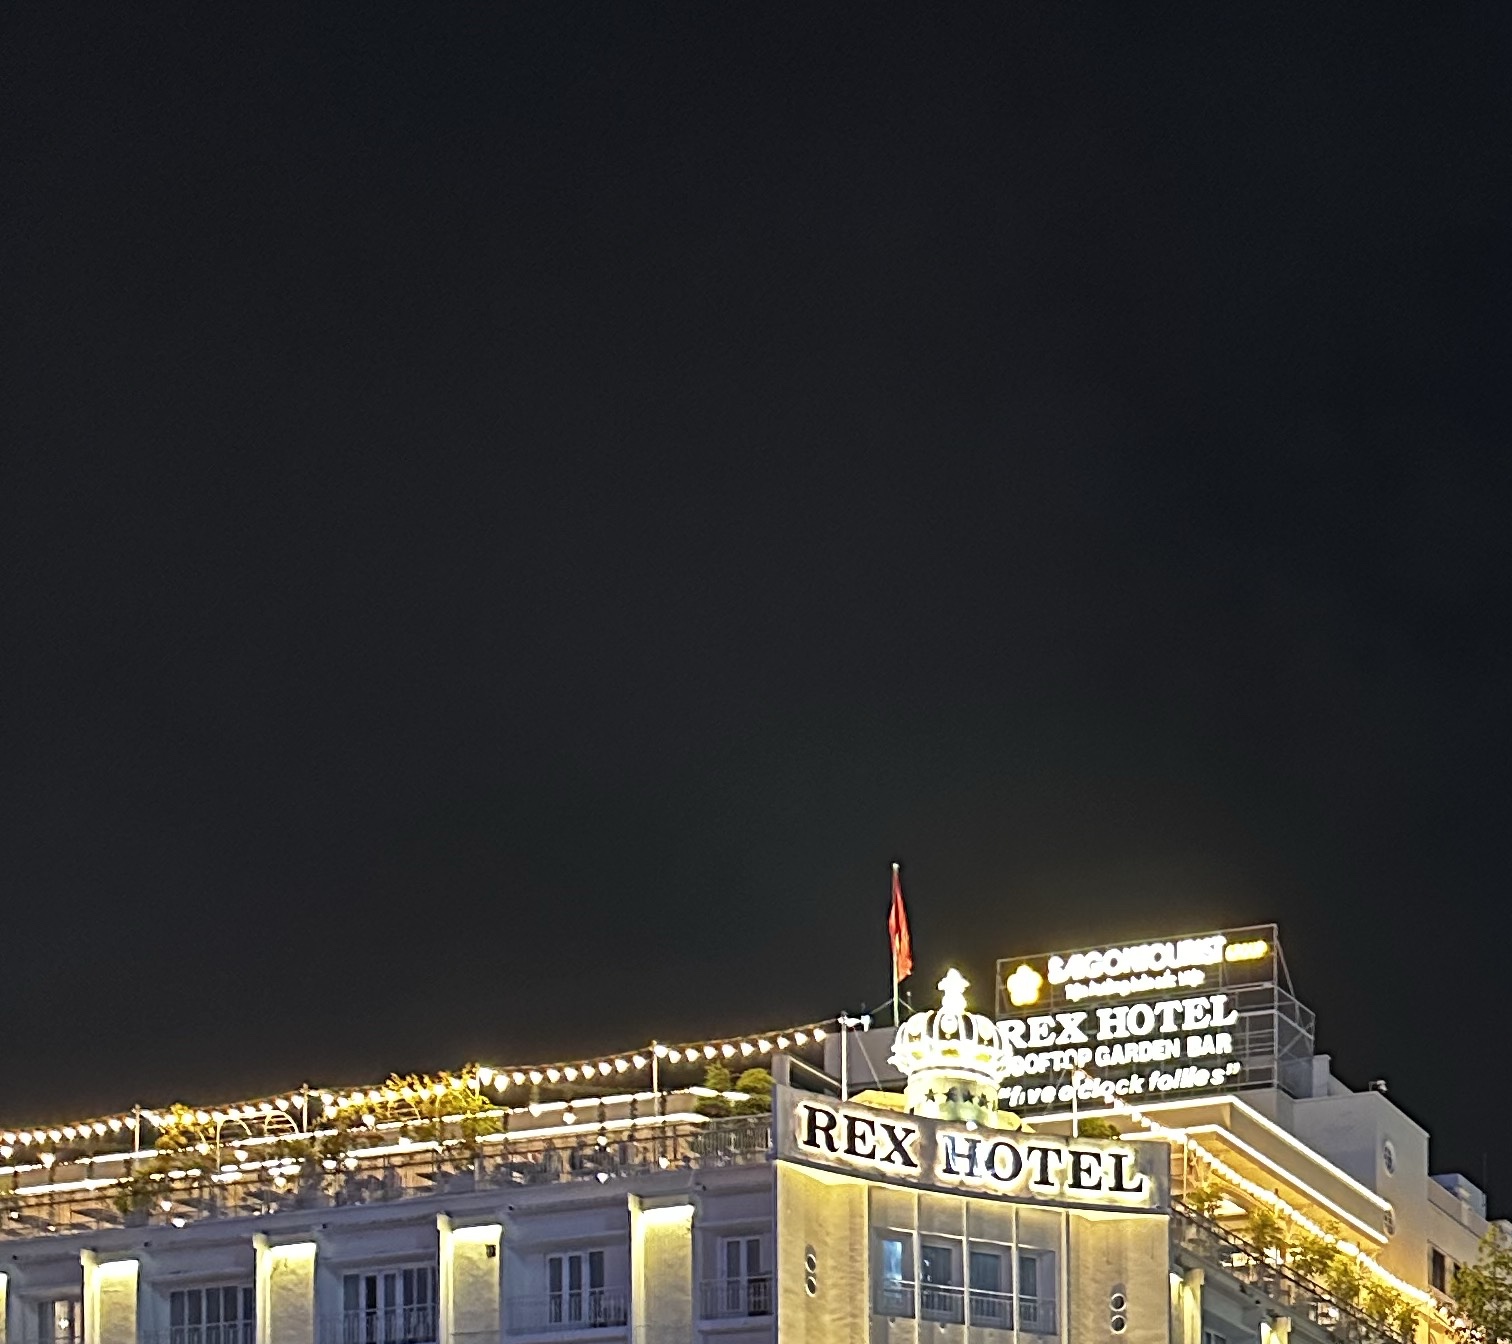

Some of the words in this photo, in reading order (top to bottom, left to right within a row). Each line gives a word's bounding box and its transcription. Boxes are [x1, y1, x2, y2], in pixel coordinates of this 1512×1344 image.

[1048, 935, 1227, 985] SAGOOUST
[996, 1012, 1088, 1050] REX
[1095, 995, 1239, 1041] HOTEL
[1004, 1047, 1093, 1078] OOFTOP
[1095, 1038, 1181, 1067] GARDEN
[1186, 1032, 1233, 1058] BAR
[1057, 1074, 1146, 1104] oclock
[802, 1103, 918, 1169] REX
[941, 1134, 1143, 1194] HOTEL
